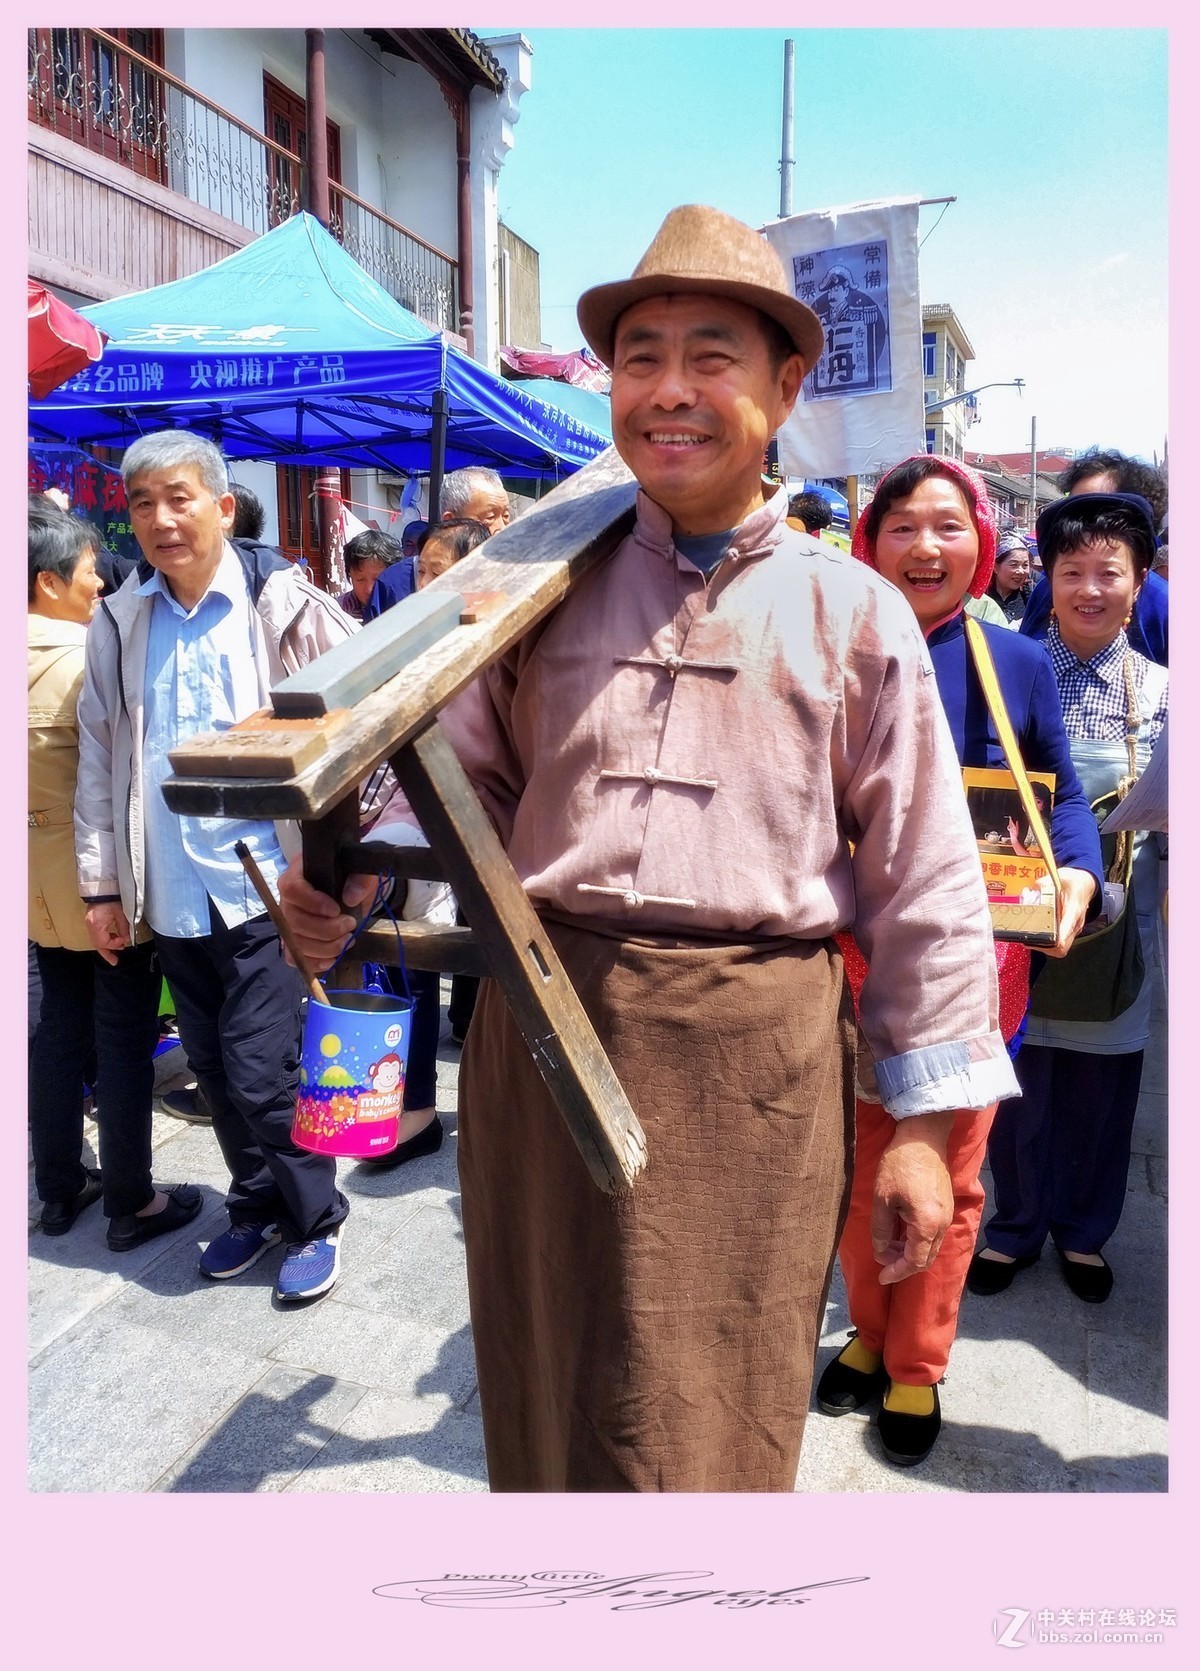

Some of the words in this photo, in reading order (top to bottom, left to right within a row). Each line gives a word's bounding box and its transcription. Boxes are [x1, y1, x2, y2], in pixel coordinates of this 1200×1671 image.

[863, 245, 882, 289] 常備
[50, 361, 165, 393] 著名品牌
[189, 354, 346, 390] 央视推广产品
[826, 326, 856, 385] 仁丹
[360, 1091, 402, 1108] monkey
